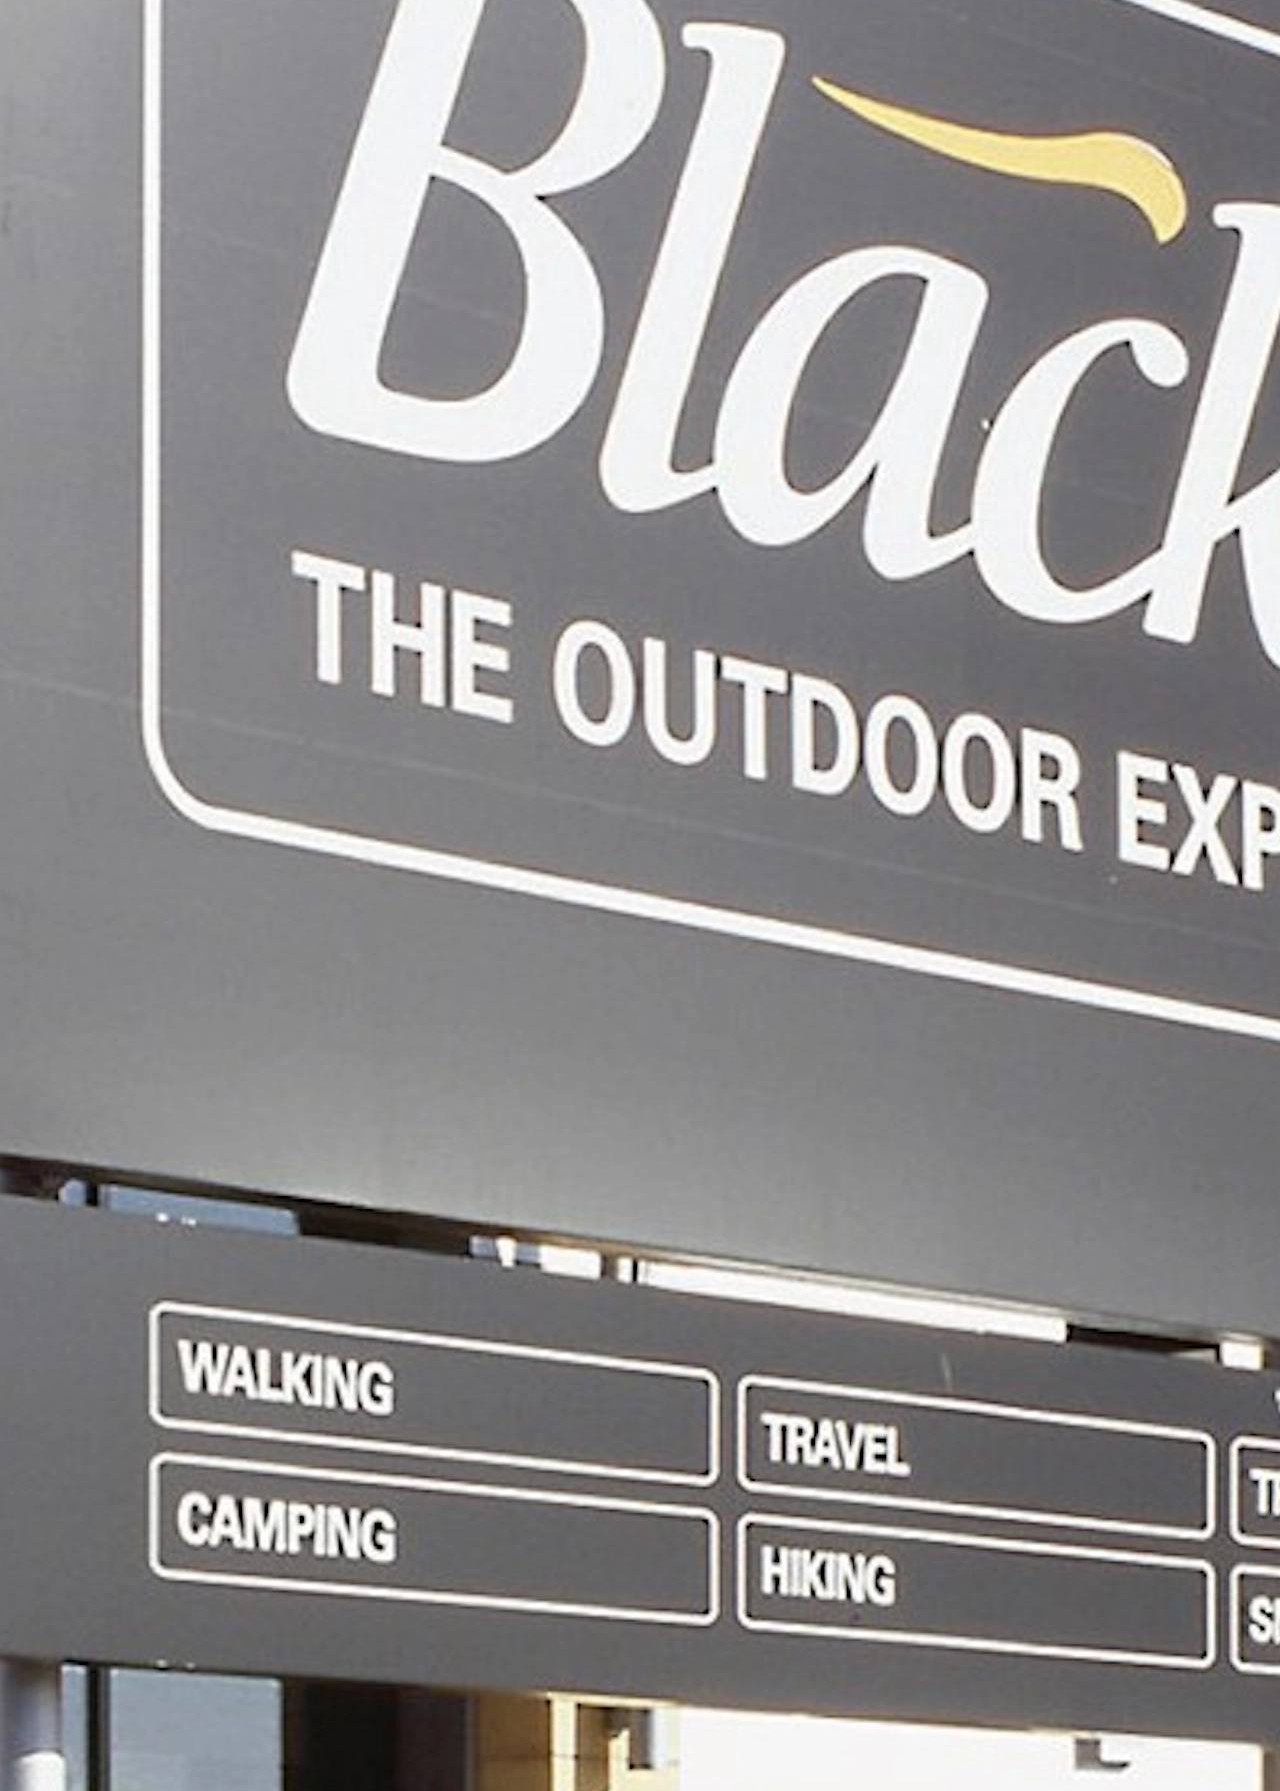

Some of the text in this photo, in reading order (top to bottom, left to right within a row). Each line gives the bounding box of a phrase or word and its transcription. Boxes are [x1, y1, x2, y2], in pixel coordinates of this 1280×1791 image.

[291, 551, 513, 725] THE
[554, 620, 1084, 852] OUTDOOR
[177, 1339, 394, 1415] WALKING
[760, 1412, 911, 1477] TRAVEL
[177, 1491, 396, 1563] CAMPING
[761, 1545, 895, 1607] HIKING
